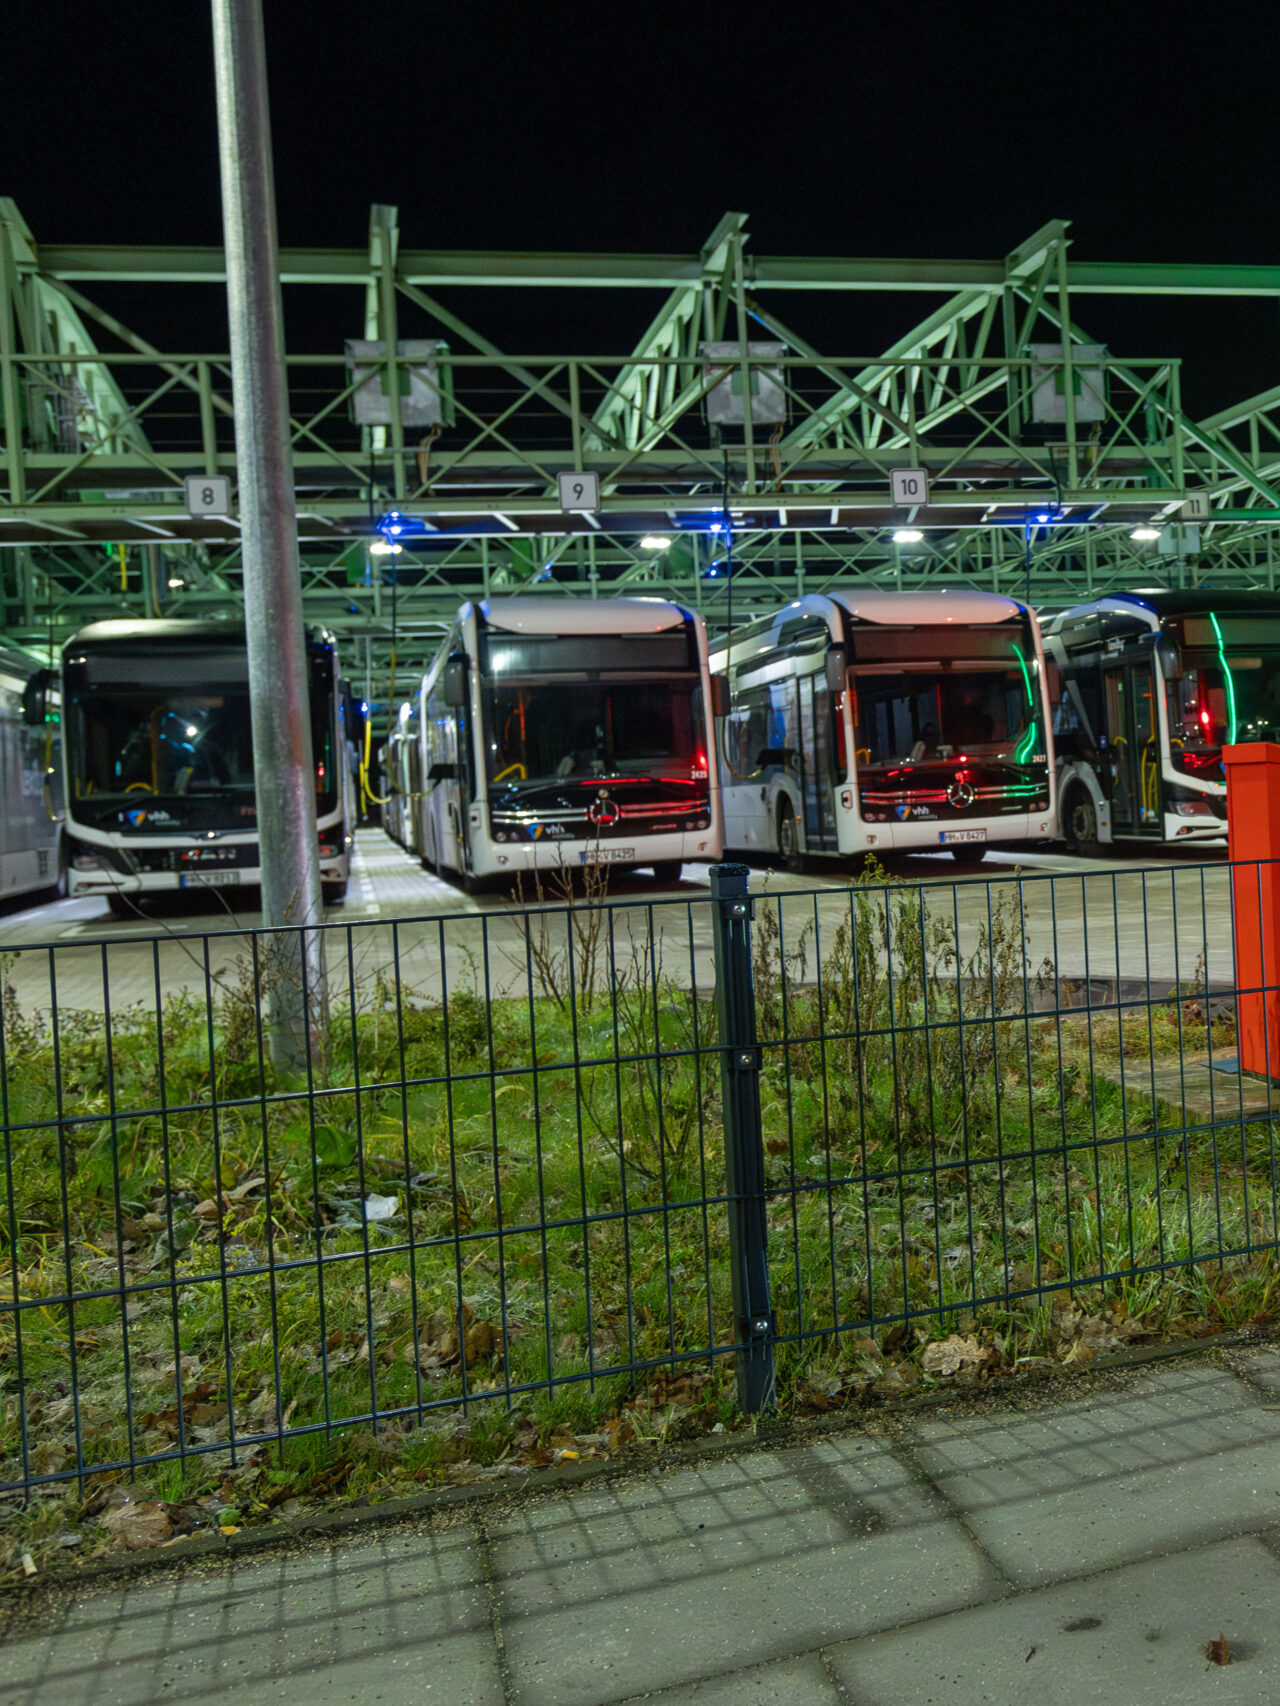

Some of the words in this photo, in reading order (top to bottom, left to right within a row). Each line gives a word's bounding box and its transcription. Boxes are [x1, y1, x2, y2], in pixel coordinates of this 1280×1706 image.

[573, 483, 584, 500] 9
[901, 479, 917, 495] 10
[202, 487, 214, 505] 8
